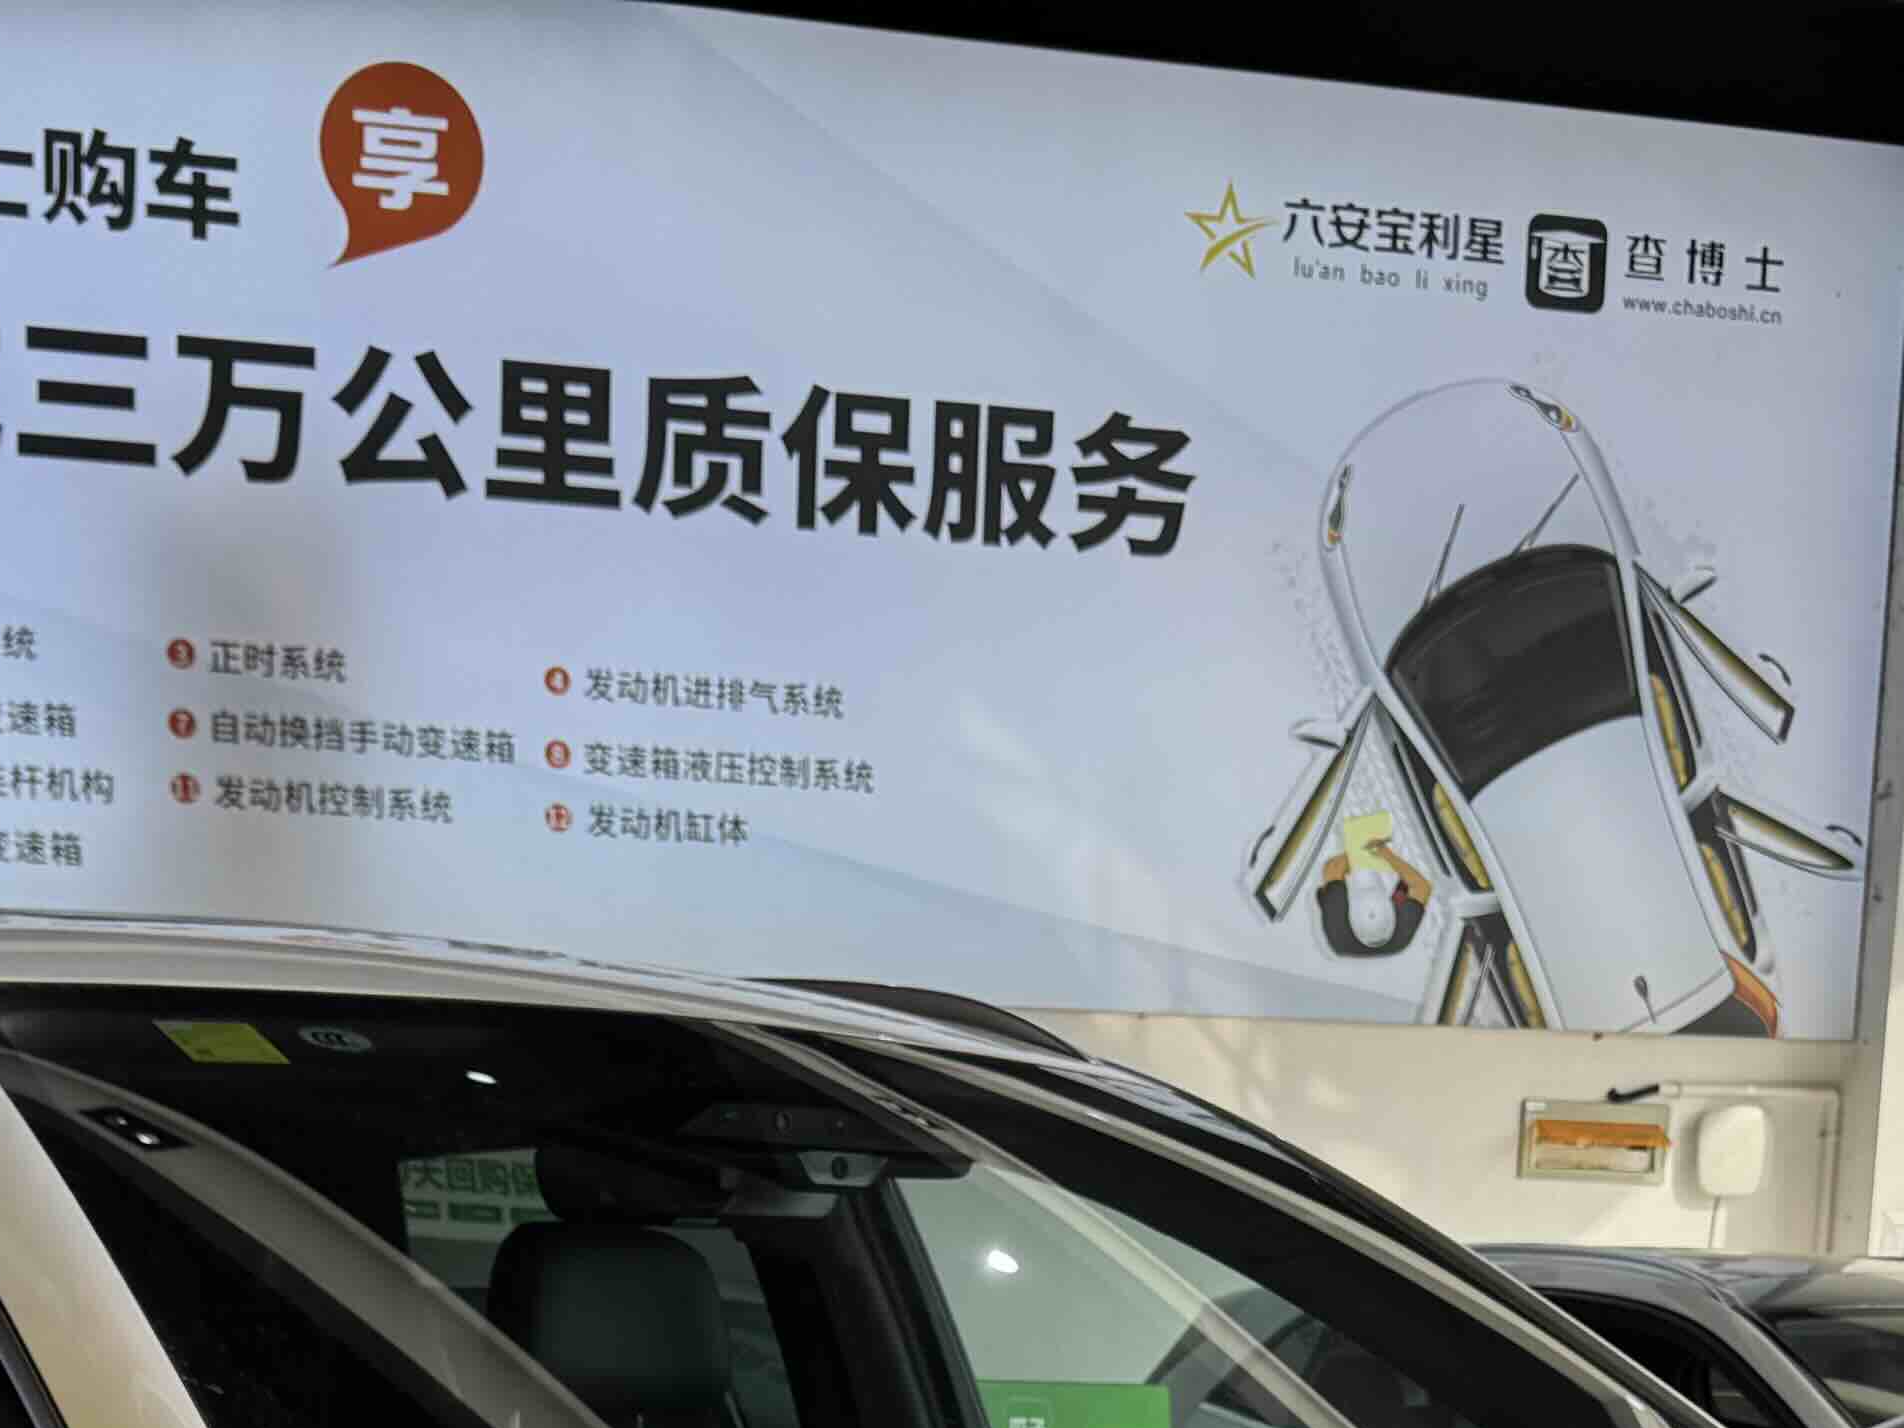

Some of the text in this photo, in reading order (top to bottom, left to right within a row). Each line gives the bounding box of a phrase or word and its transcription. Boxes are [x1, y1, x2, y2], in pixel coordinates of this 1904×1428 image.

[351, 107, 449, 211] 享
[1282, 197, 1505, 265] 六安宝利星
[1361, 262, 1400, 288] bao
[1416, 268, 1429, 289] li
[1442, 274, 1489, 300] xing
[1624, 233, 1785, 293] 查博士
[1622, 294, 1782, 325] www.chaboshi.cn
[209, 640, 347, 683] 正时系统
[584, 667, 844, 719] 发动机进排气系统
[210, 710, 516, 765] 自动换挡手动变速箱
[584, 743, 874, 794] 变速箱液压控制系统
[216, 776, 453, 824] 发动机控制系统
[589, 803, 748, 846] 发动机缸体
